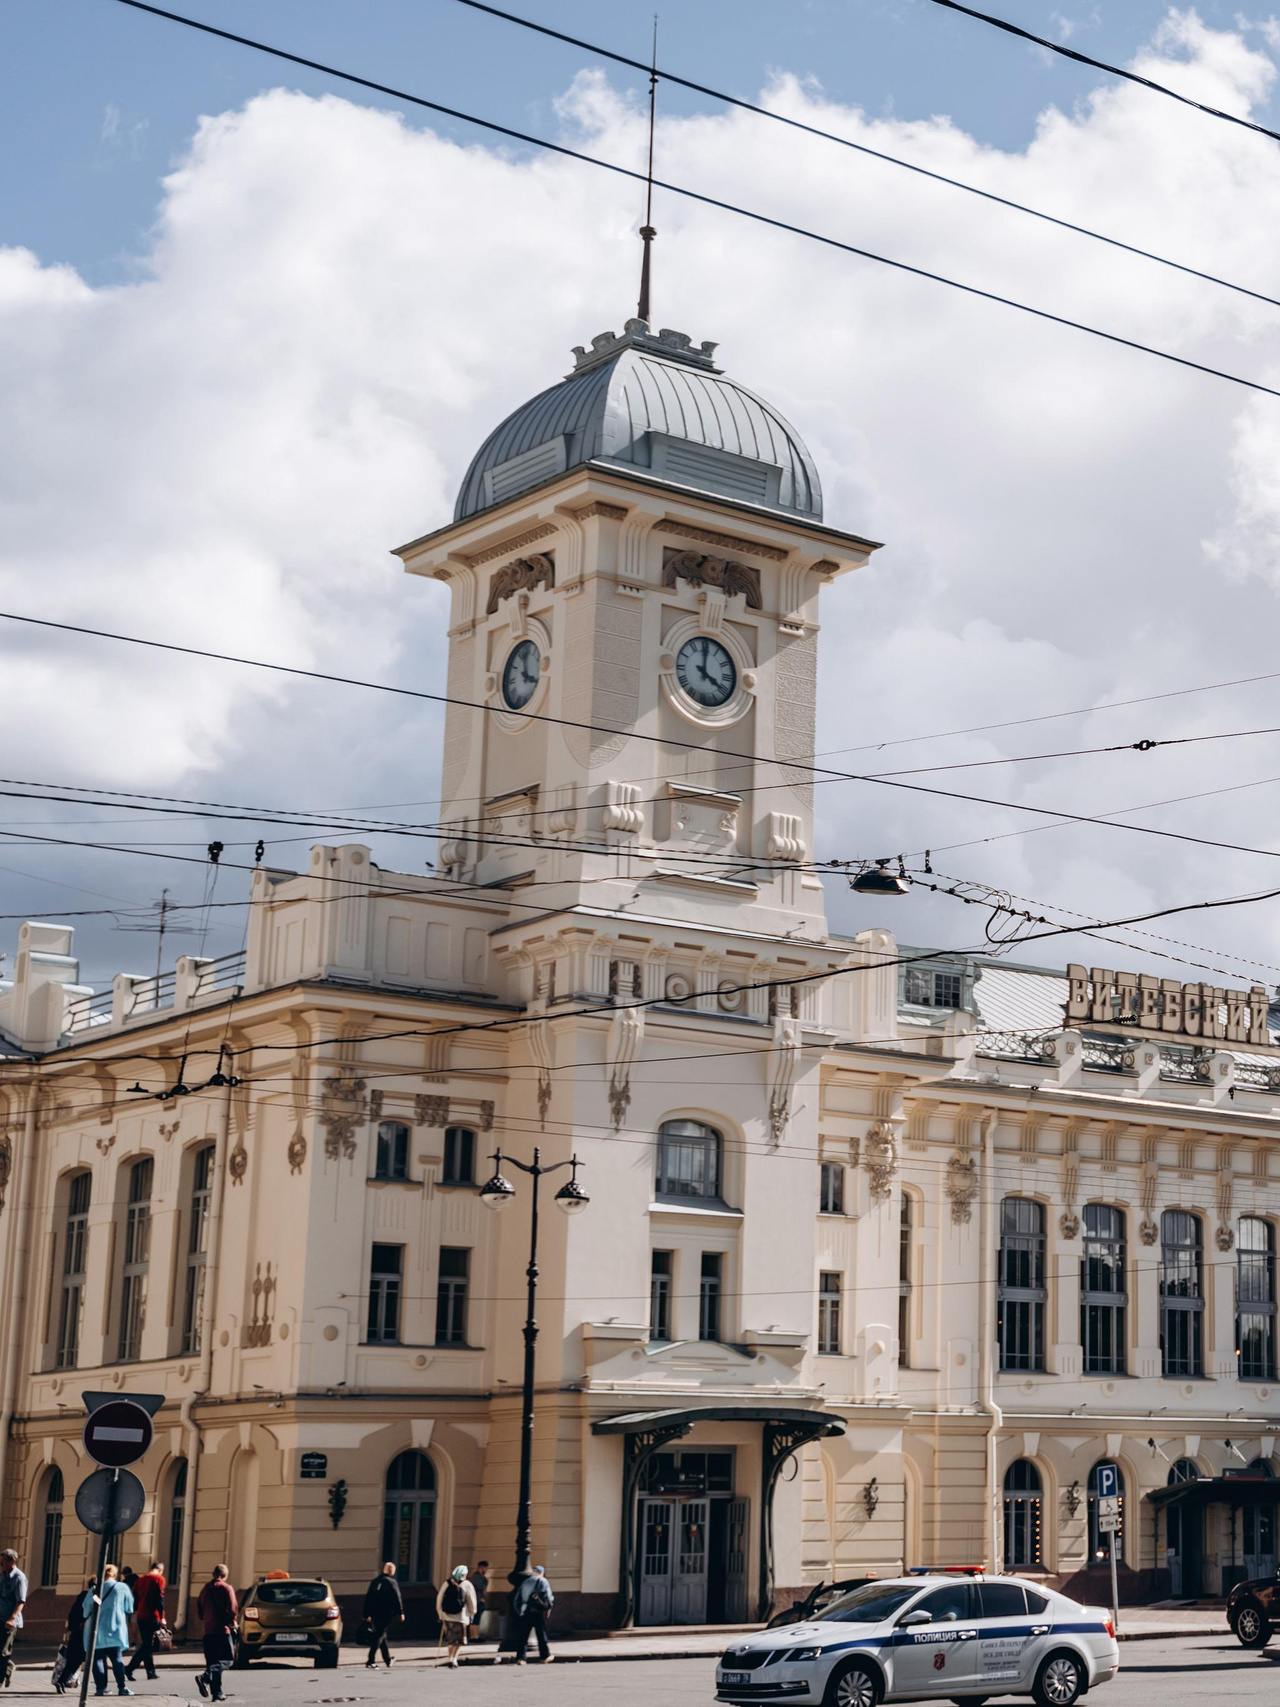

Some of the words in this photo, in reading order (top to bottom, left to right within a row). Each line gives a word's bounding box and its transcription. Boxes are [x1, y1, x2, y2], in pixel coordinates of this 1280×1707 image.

[1066, 962, 1270, 1046] ВИТЕБСКИЙ
[1102, 1469, 1114, 1495] P
[914, 1631, 958, 1643] ПОЛИЦИЯ
